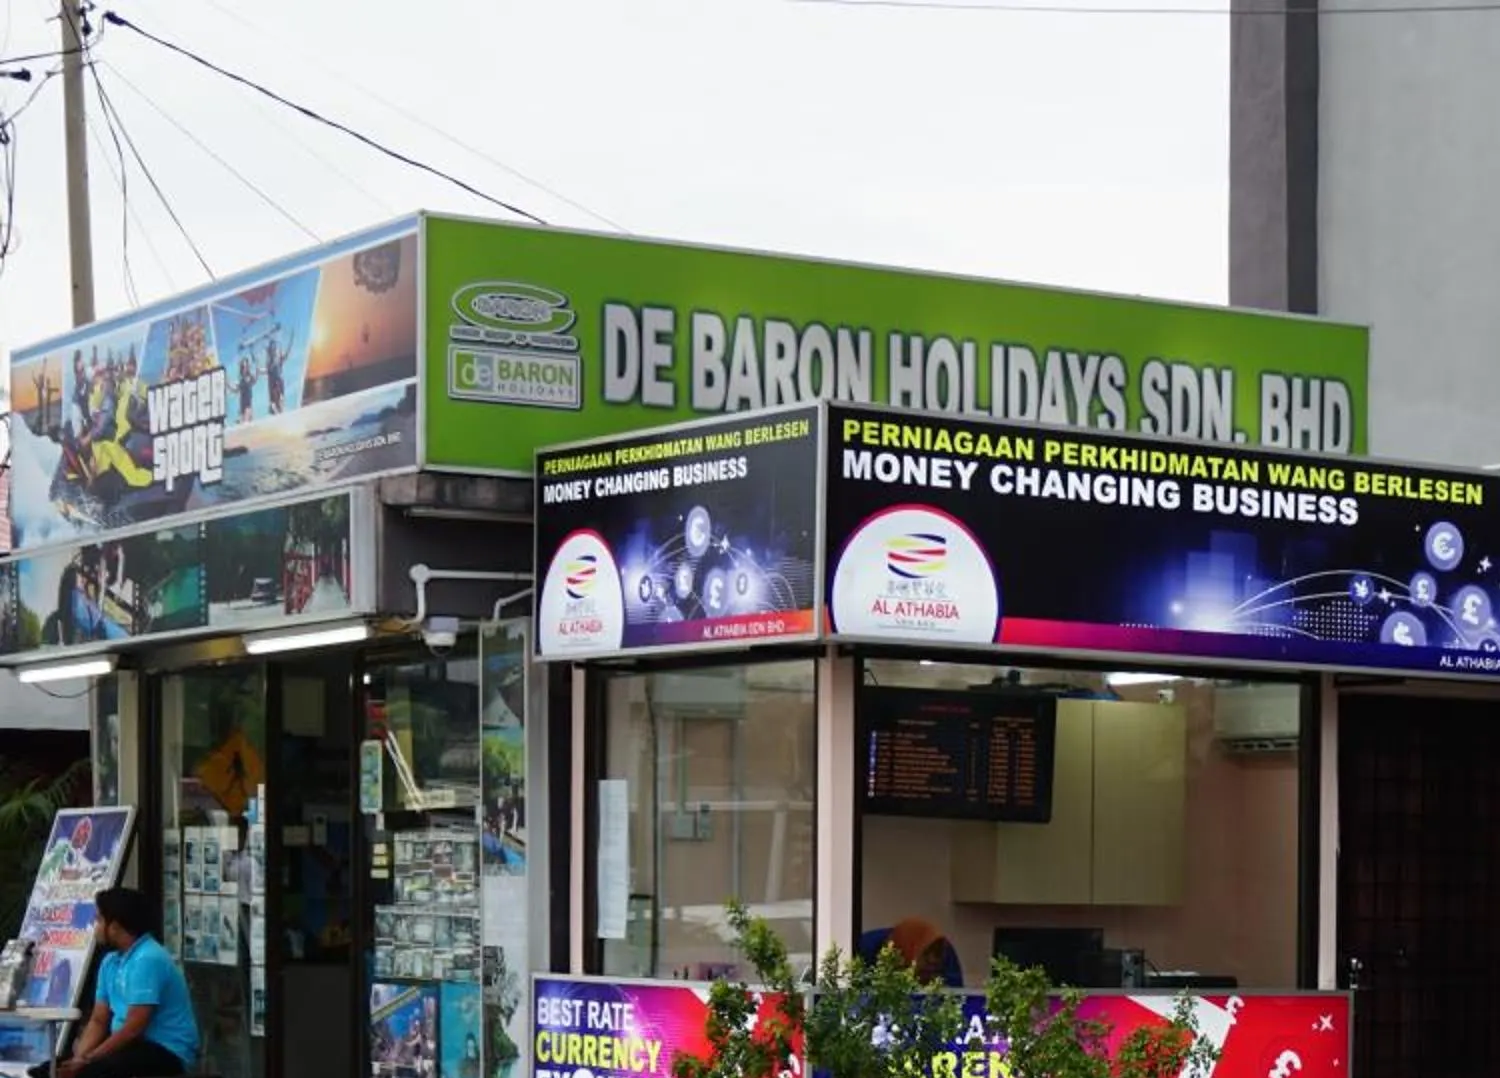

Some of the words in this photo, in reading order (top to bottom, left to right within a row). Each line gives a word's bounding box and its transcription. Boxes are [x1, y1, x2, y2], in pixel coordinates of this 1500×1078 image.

[498, 359, 574, 387] BARON
[603, 303, 676, 407] DE
[692, 312, 873, 412] BARON
[889, 333, 1127, 431] HOLIDAYS
[1140, 360, 1248, 444] SDN.
[1261, 373, 1351, 455] BHD
[544, 452, 613, 476] PERNIAGAAN
[614, 436, 703, 466] PERKHIDMATAN
[705, 430, 743, 452] WANG
[744, 419, 810, 446] BERLESEN
[842, 418, 1035, 461] PERNIAGAAN
[1044, 440, 1259, 483] PERKHIDMATAN
[1268, 462, 1346, 491] WANG
[1354, 471, 1484, 506] BERLESEN
[543, 479, 593, 505] MONEY
[595, 467, 670, 498] CHANGING
[673, 456, 749, 488] BUSINESS
[842, 449, 979, 491] MONEY
[990, 464, 1182, 510] CHANGING
[1192, 482, 1360, 526] BUSINESS
[767, 619, 785, 633] BHD
[871, 598, 892, 615] AL
[893, 600, 961, 620] ATHABIA
[1440, 654, 1454, 668] AL
[537, 996, 583, 1028] BEST
[587, 1000, 635, 1031] RATE
[536, 1030, 663, 1074] CURRENCY
